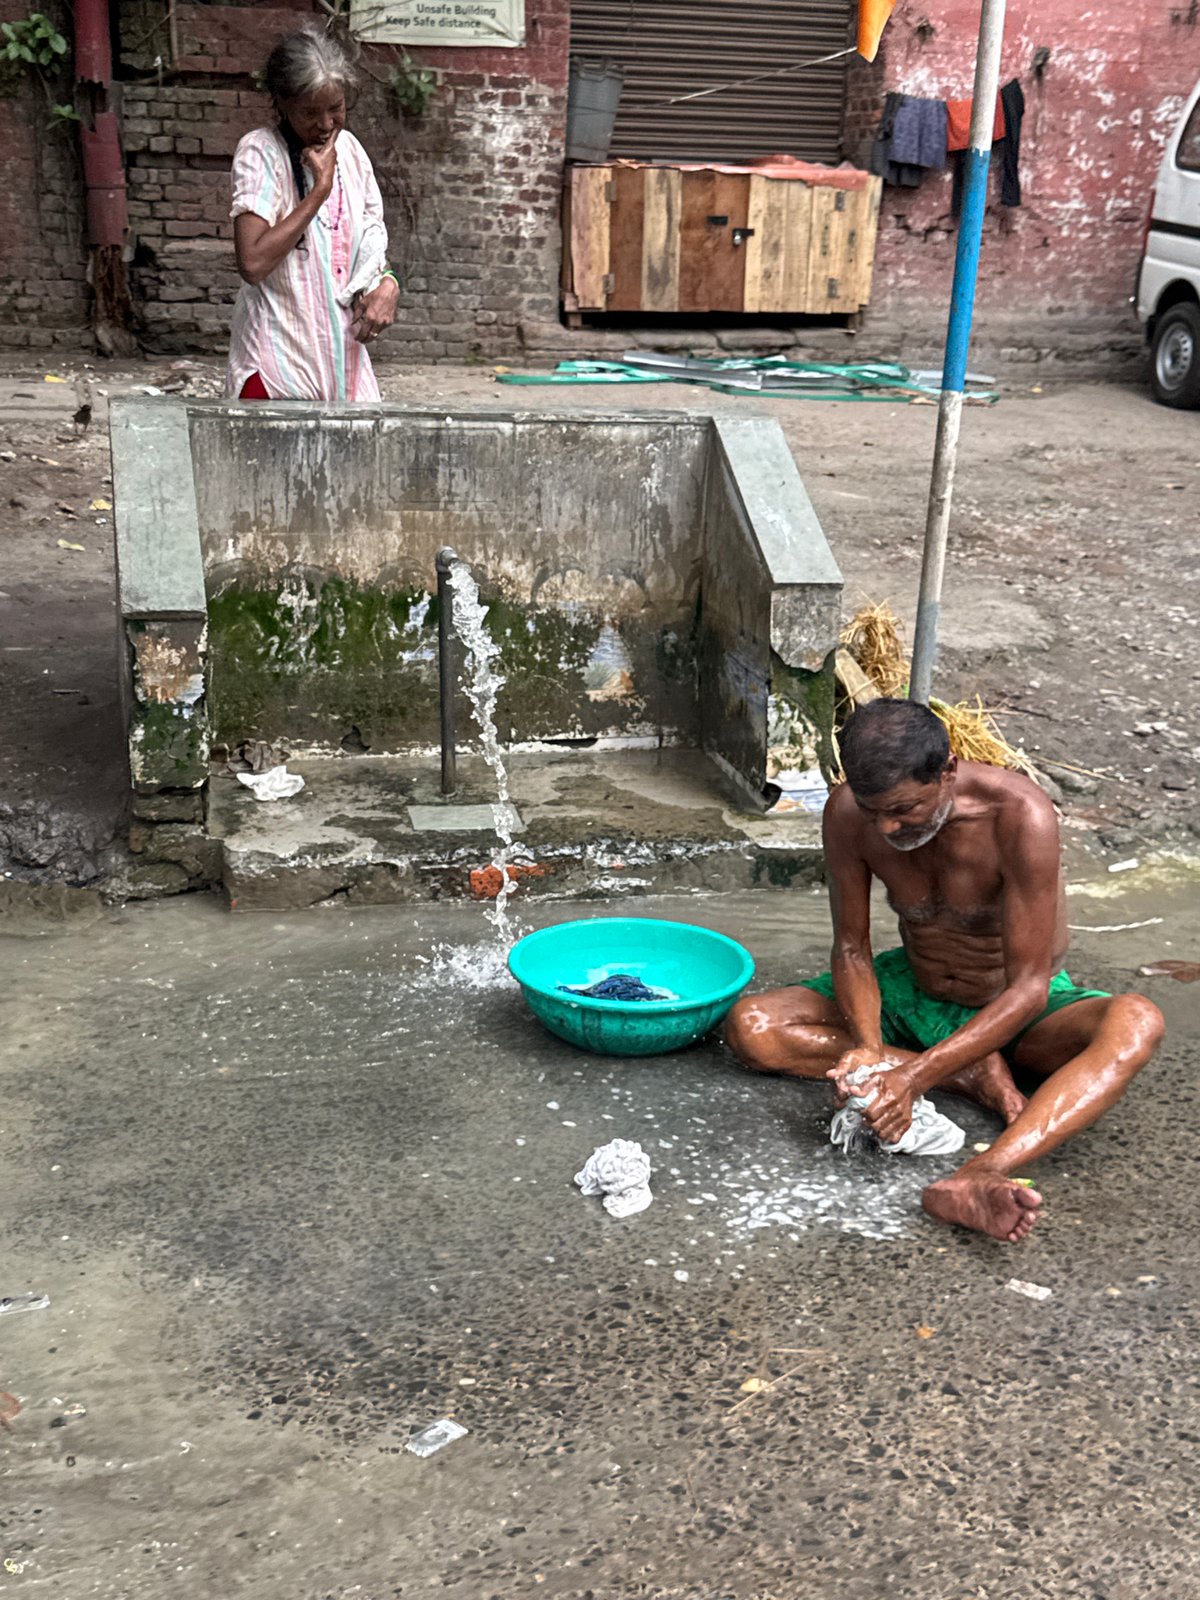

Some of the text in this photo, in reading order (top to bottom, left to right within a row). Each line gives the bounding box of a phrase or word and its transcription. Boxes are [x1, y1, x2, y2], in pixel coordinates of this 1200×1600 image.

[417, 4, 496, 18] Unsafe Building
[385, 15, 481, 28] Keep Safe distance
